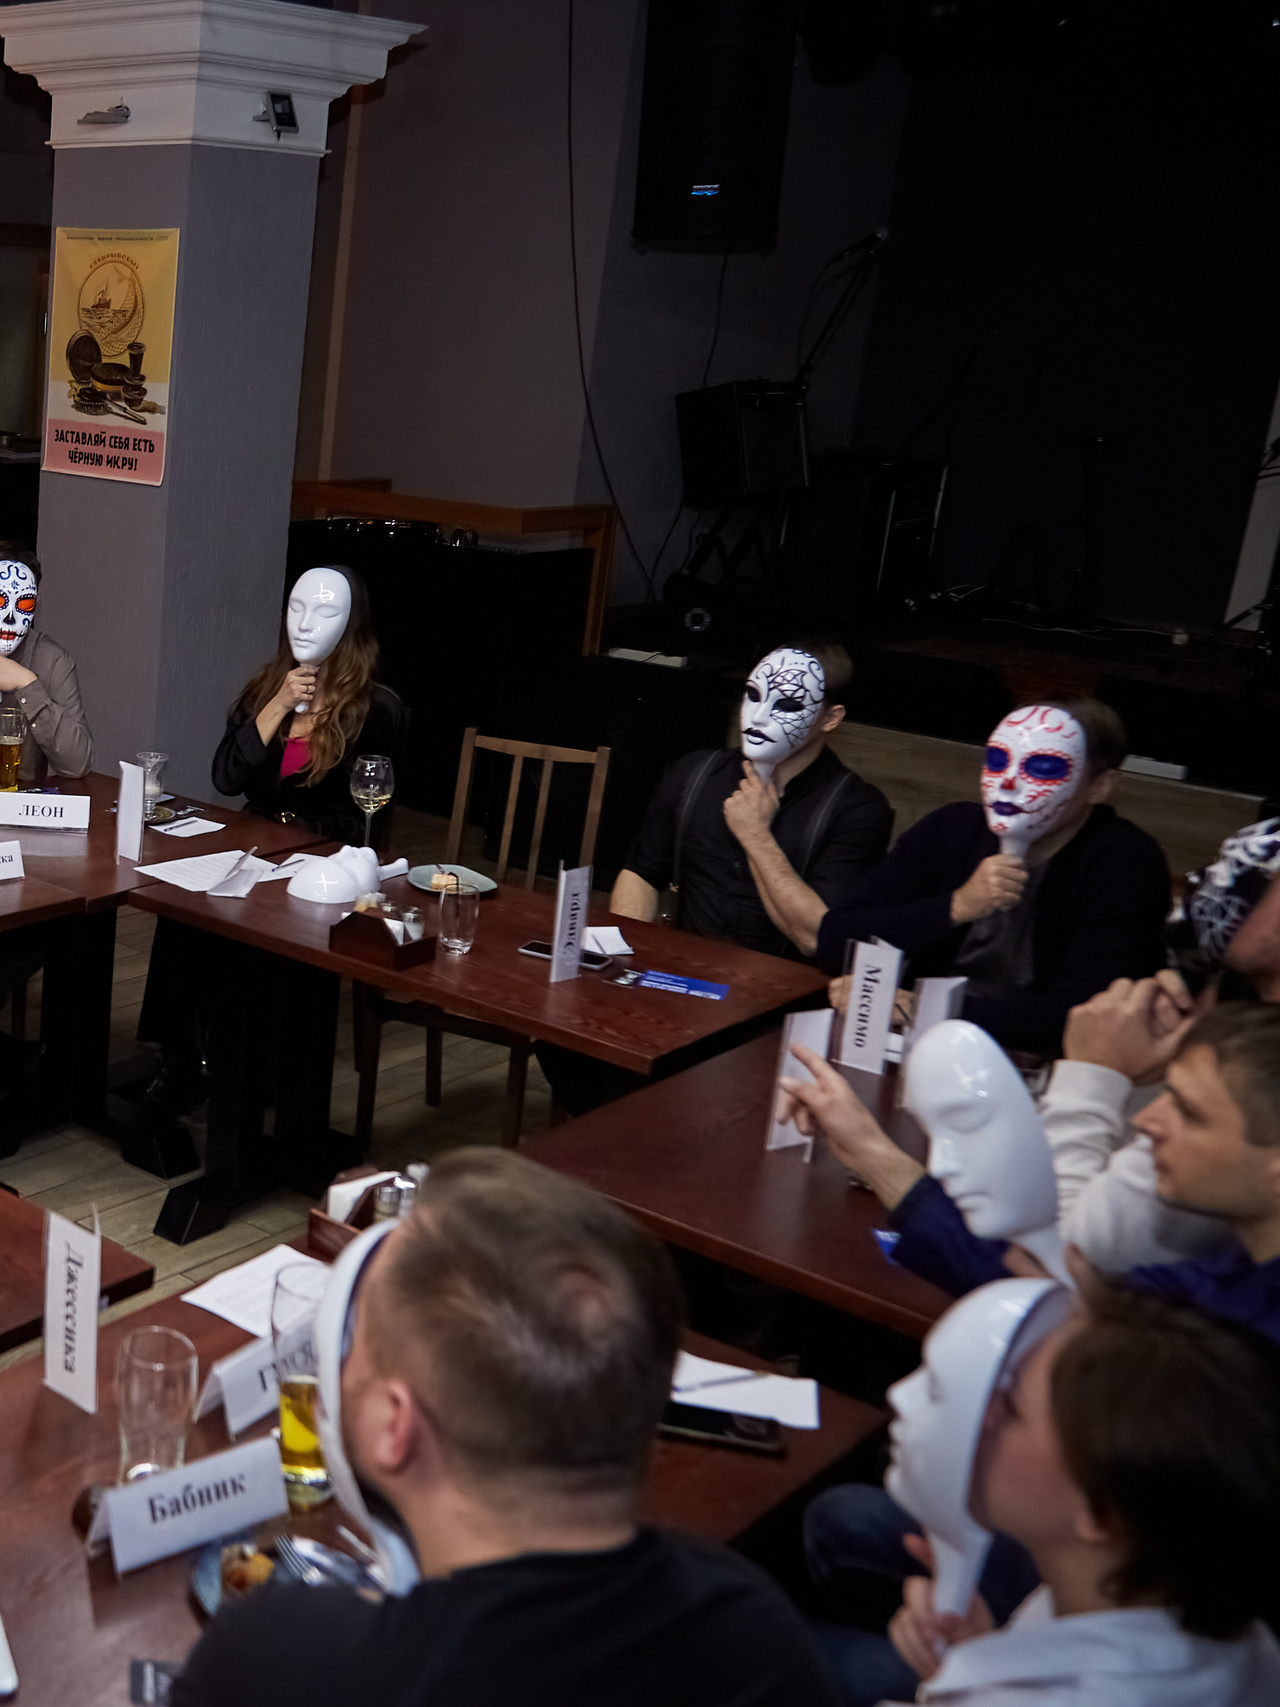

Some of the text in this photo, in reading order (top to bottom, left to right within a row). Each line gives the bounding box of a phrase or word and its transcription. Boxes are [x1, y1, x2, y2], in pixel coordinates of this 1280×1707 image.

[54, 429, 155, 453] ЗАСТАВЛЯЙ СЕБЯ ЕСТЬ
[68, 447, 138, 472] ЧЁРНУЮ ИКРУ!
[18, 803, 65, 818] ЛЕОН
[854, 963, 882, 1049] Массимо
[63, 1241, 85, 1374] Джессика
[147, 1469, 246, 1525] Бабник
